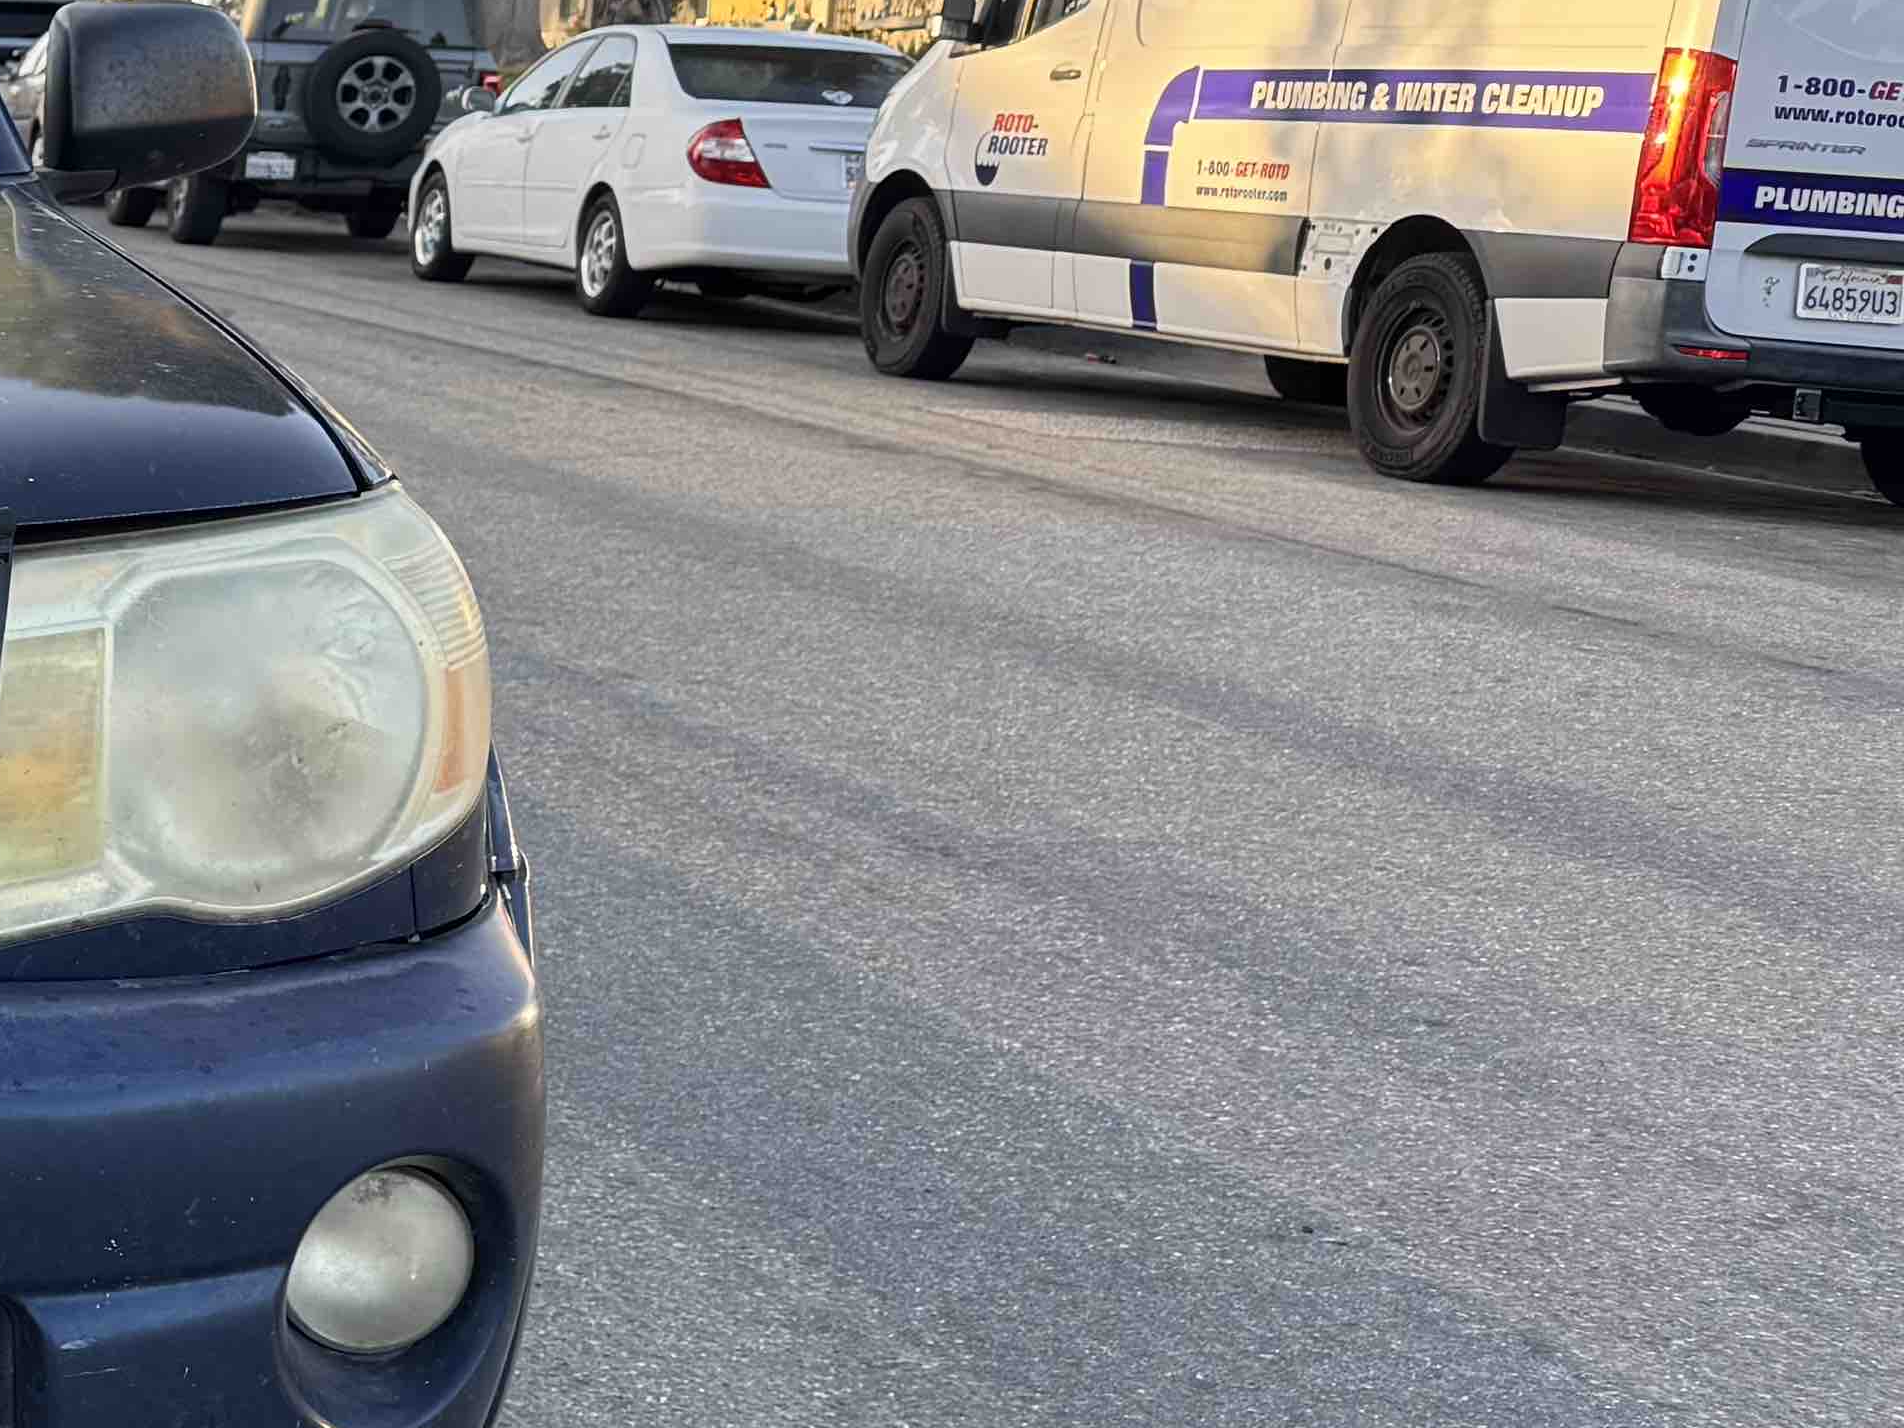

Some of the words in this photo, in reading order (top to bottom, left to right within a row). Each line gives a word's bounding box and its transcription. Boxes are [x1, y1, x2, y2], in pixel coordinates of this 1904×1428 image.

[1250, 81, 1368, 111] PLUMBING
[1370, 85, 1390, 111] &
[1395, 82, 1476, 113] WATER
[1481, 83, 1605, 118] CLEANUP
[1778, 75, 1904, 101] 1-800-GE
[993, 113, 1039, 133] ROTO-
[988, 135, 1049, 156] ROOTER
[1745, 138, 1867, 155] SPRINTER
[1754, 185, 1904, 218] PLUMBING
[1804, 285, 1898, 315] 64859U3
